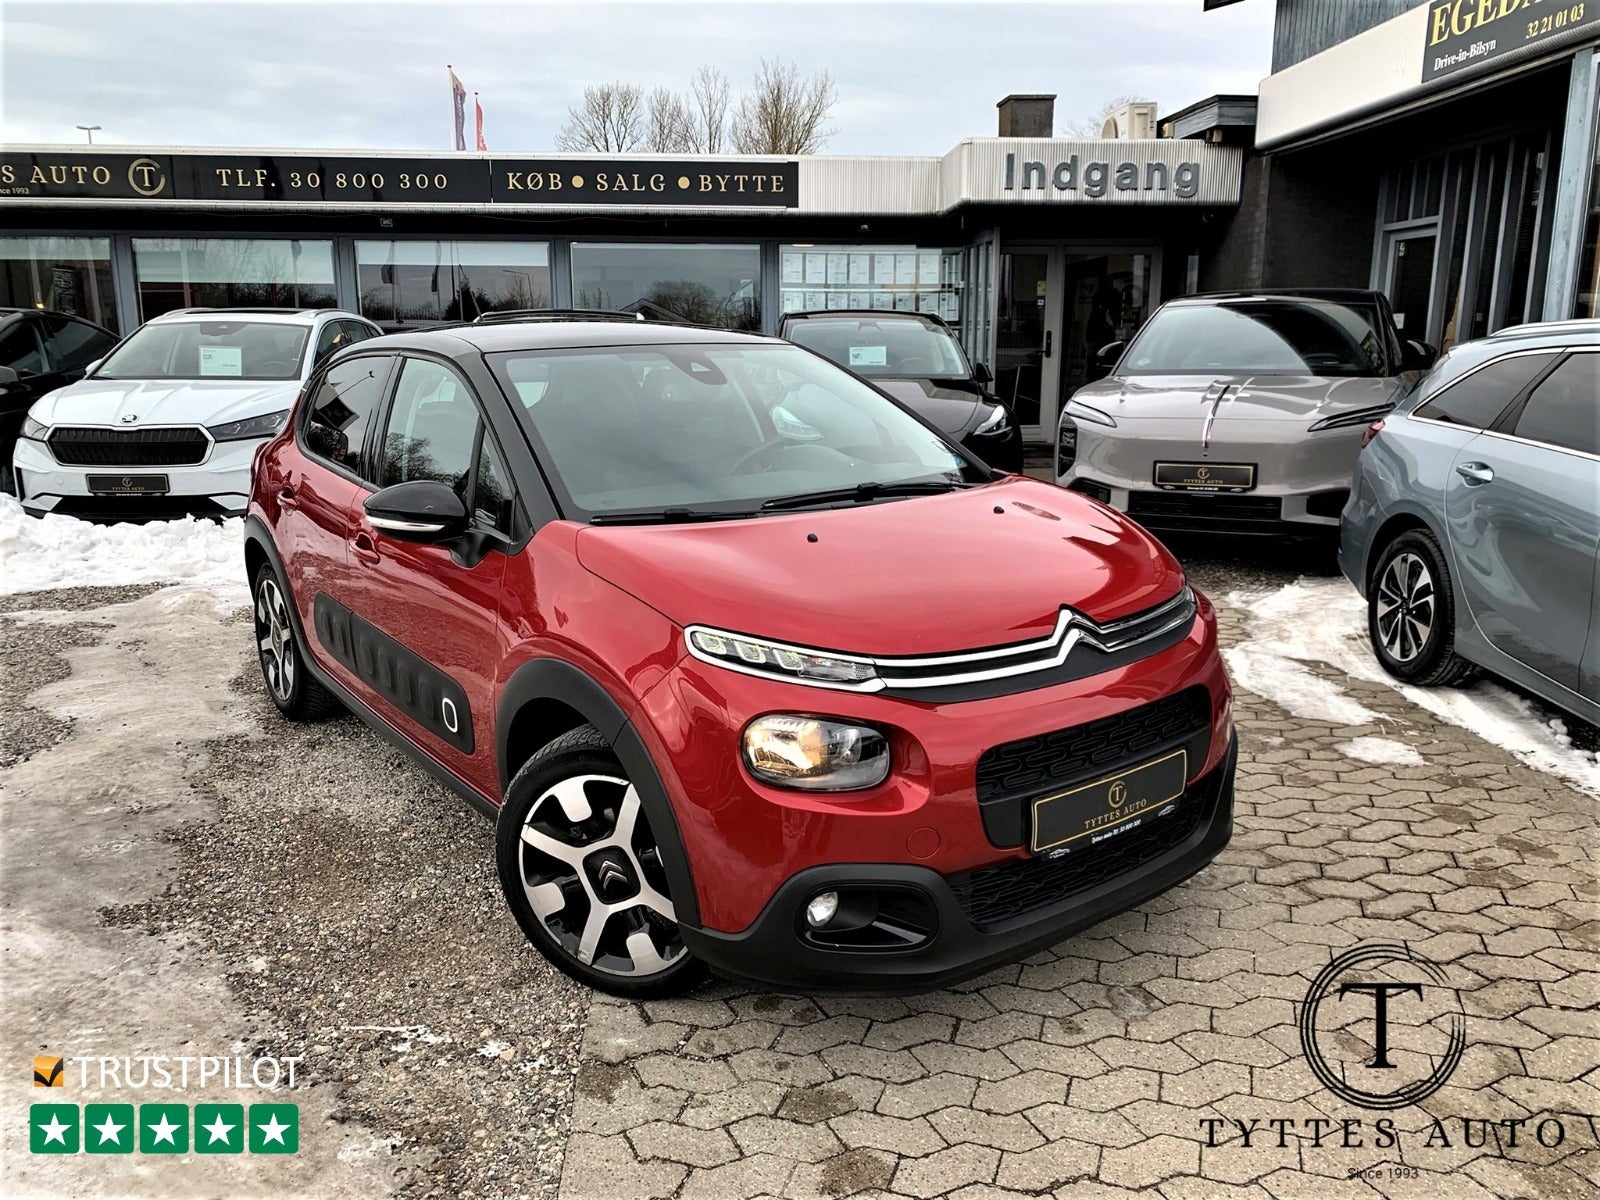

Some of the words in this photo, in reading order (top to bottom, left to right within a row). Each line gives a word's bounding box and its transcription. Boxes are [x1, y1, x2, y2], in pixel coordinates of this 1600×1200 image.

[1429, 0, 1542, 46] EGED
[1526, 20, 1539, 39] 32
[1540, 15, 1553, 34] 21
[1556, 9, 1568, 28] 01
[1570, 3, 1585, 23] 03
[1433, 39, 1497, 71] Drive-in-Bilsyn
[30, 165, 111, 185] AUTO
[216, 169, 276, 187] TLF.
[290, 172, 320, 188] 30
[336, 173, 384, 189] 800
[400, 174, 448, 189] 300
[506, 172, 563, 191] KØB
[596, 173, 666, 192] SALG
[699, 174, 785, 193] BYTTE
[1004, 153, 1200, 198] Indgang
[12, 187, 30, 195] 1993
[1084, 809, 1121, 829] TYTTES
[1123, 798, 1147, 815] AUTO
